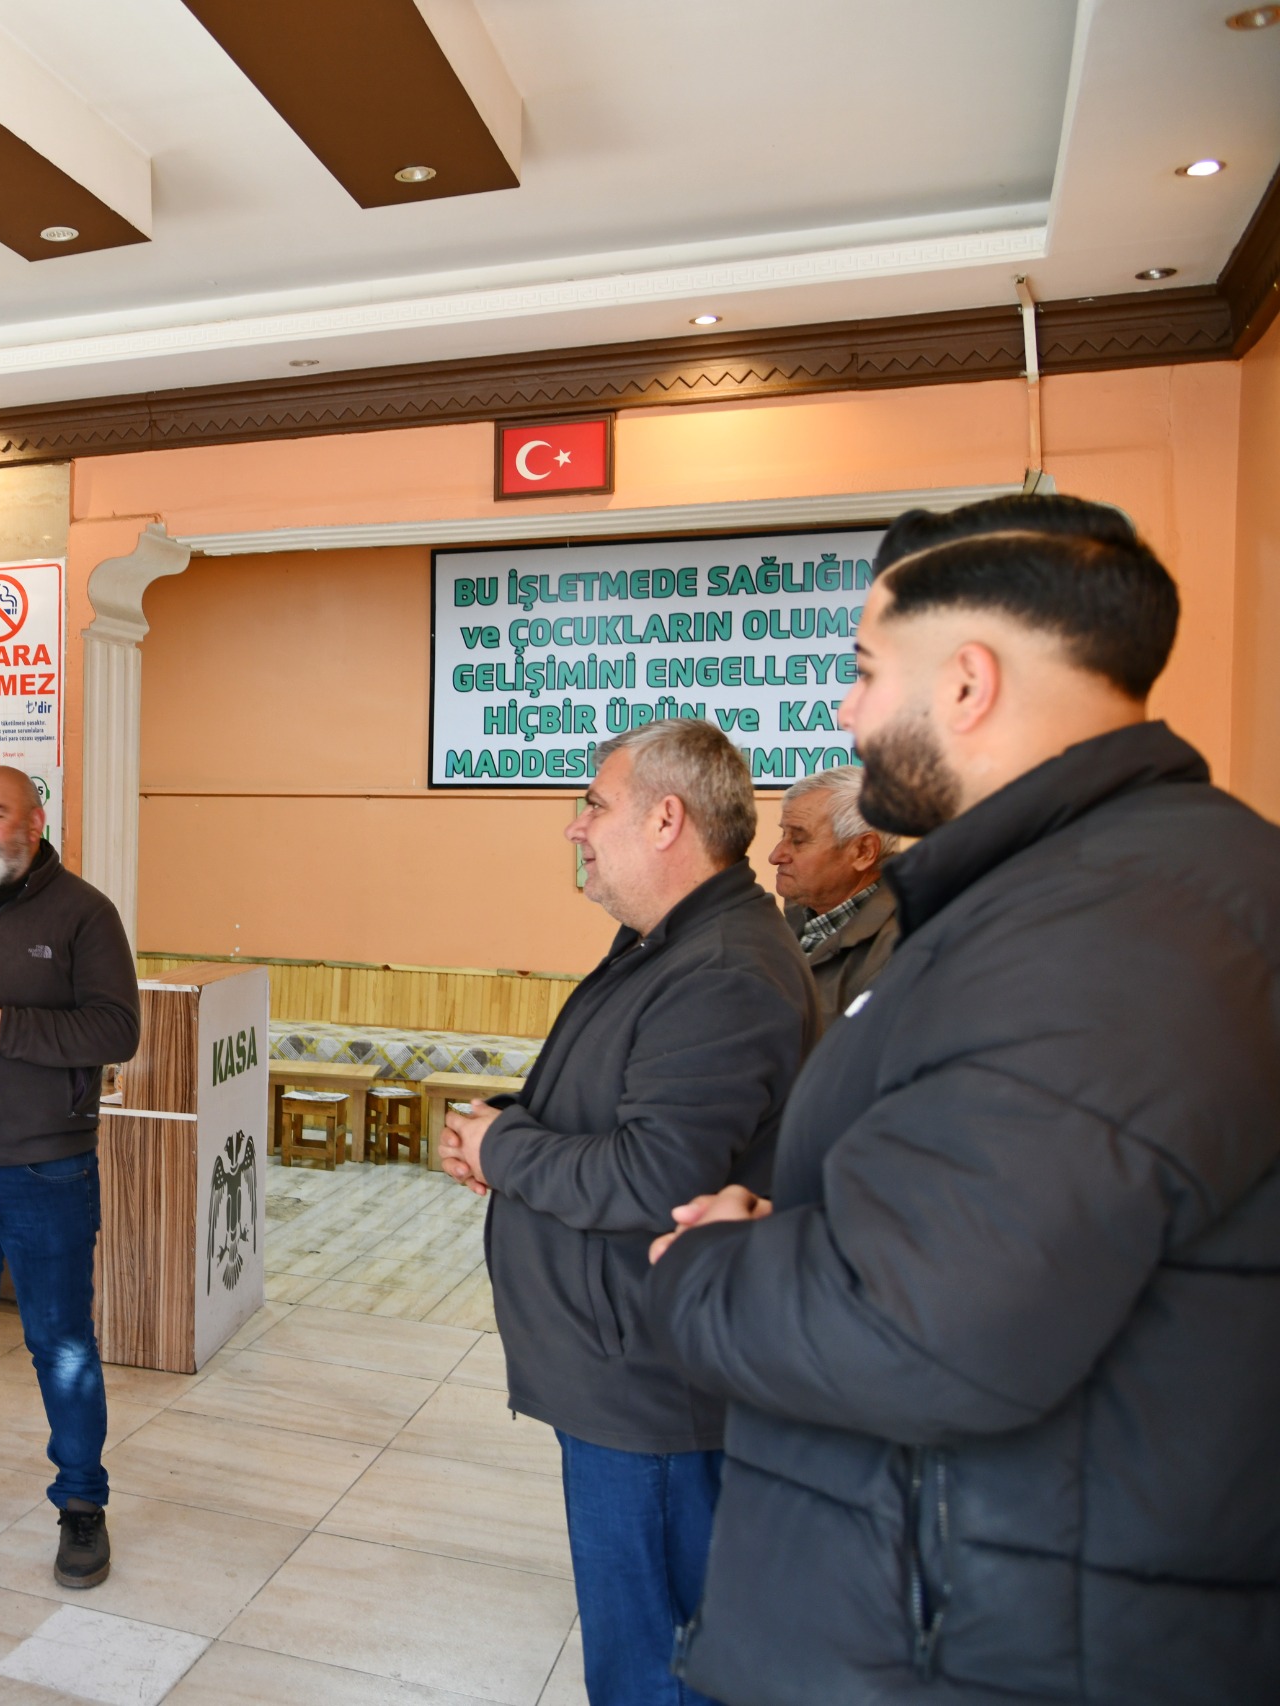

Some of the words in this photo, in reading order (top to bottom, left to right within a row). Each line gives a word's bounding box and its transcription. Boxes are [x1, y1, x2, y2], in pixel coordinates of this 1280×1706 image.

[454, 577, 498, 607] BU
[507, 567, 697, 611] İŞLETMEDE
[460, 625, 500, 649] ve
[508, 611, 732, 655] ÇOCUKLARIN
[452, 652, 636, 698] GELİŞİMİNİ
[484, 698, 597, 742] HİÇBİR
[715, 708, 759, 732] ve
[212, 1026, 258, 1087] KASA
